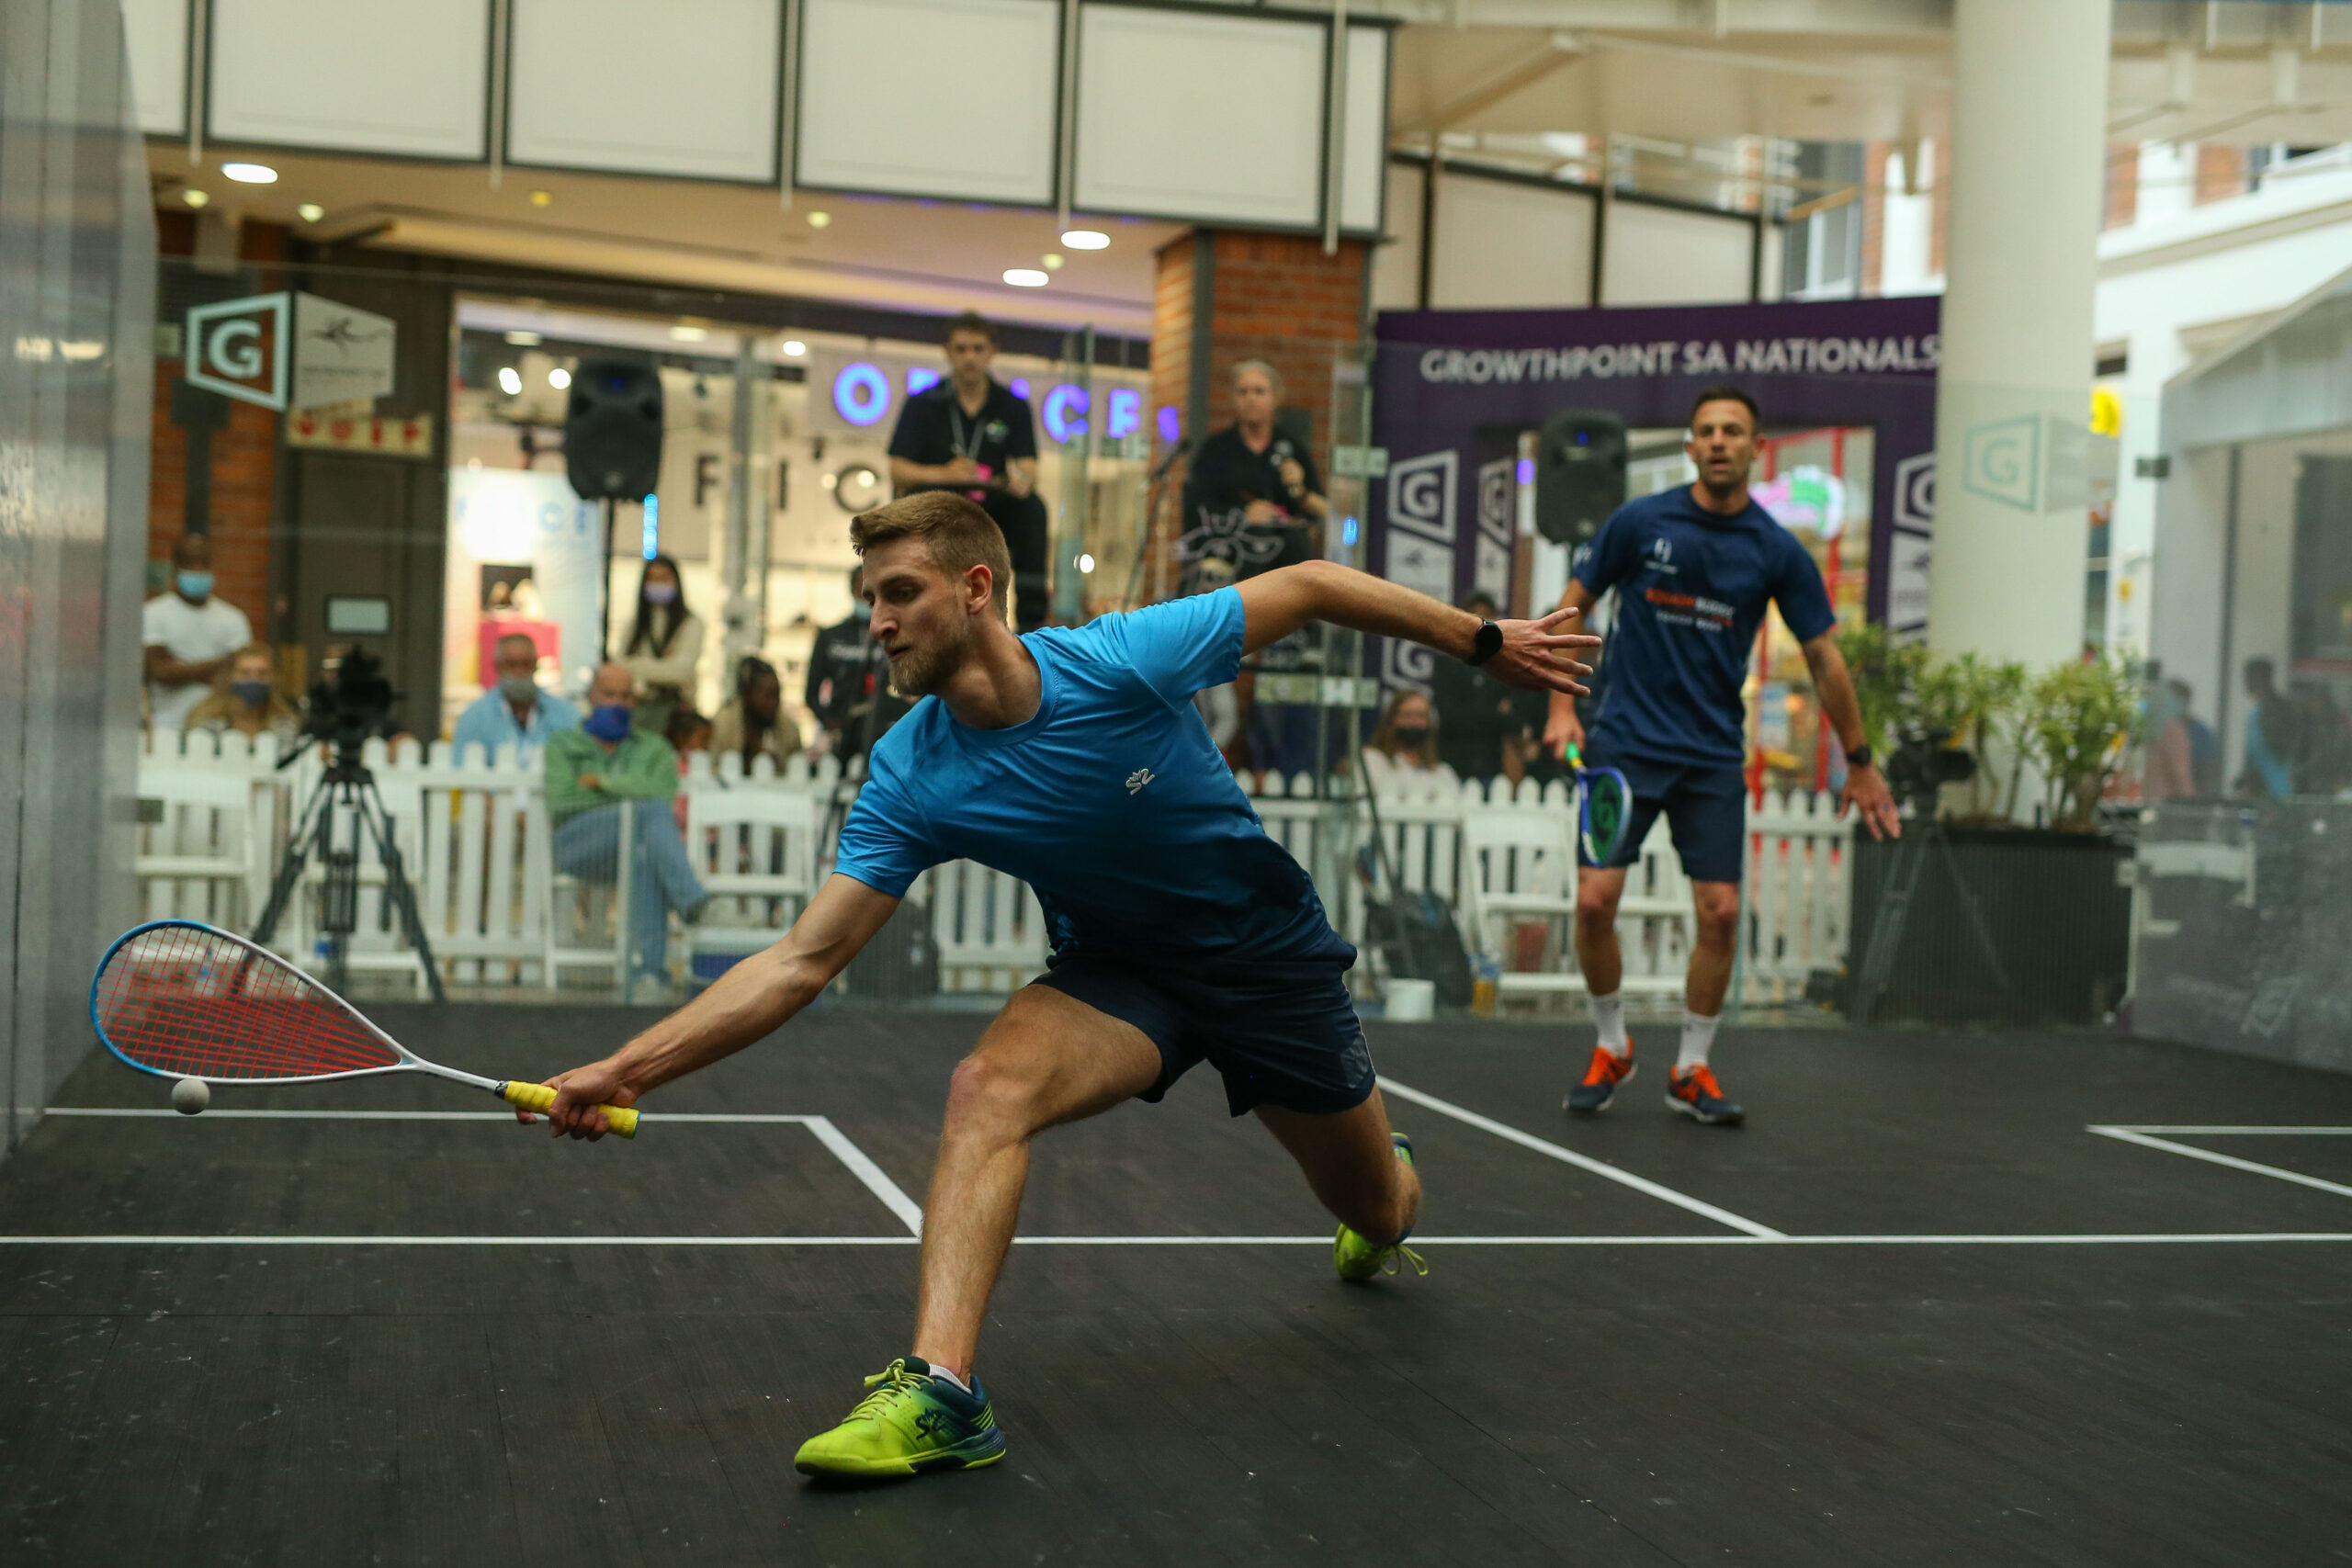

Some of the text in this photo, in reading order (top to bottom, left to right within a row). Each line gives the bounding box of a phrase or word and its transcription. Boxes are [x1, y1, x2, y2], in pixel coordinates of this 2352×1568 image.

[209, 319, 263, 378] G
[1420, 334, 1939, 384] GROWTHPOINT SA NATIONALS
[1981, 437, 2020, 485] G
[1402, 471, 1441, 519] G
